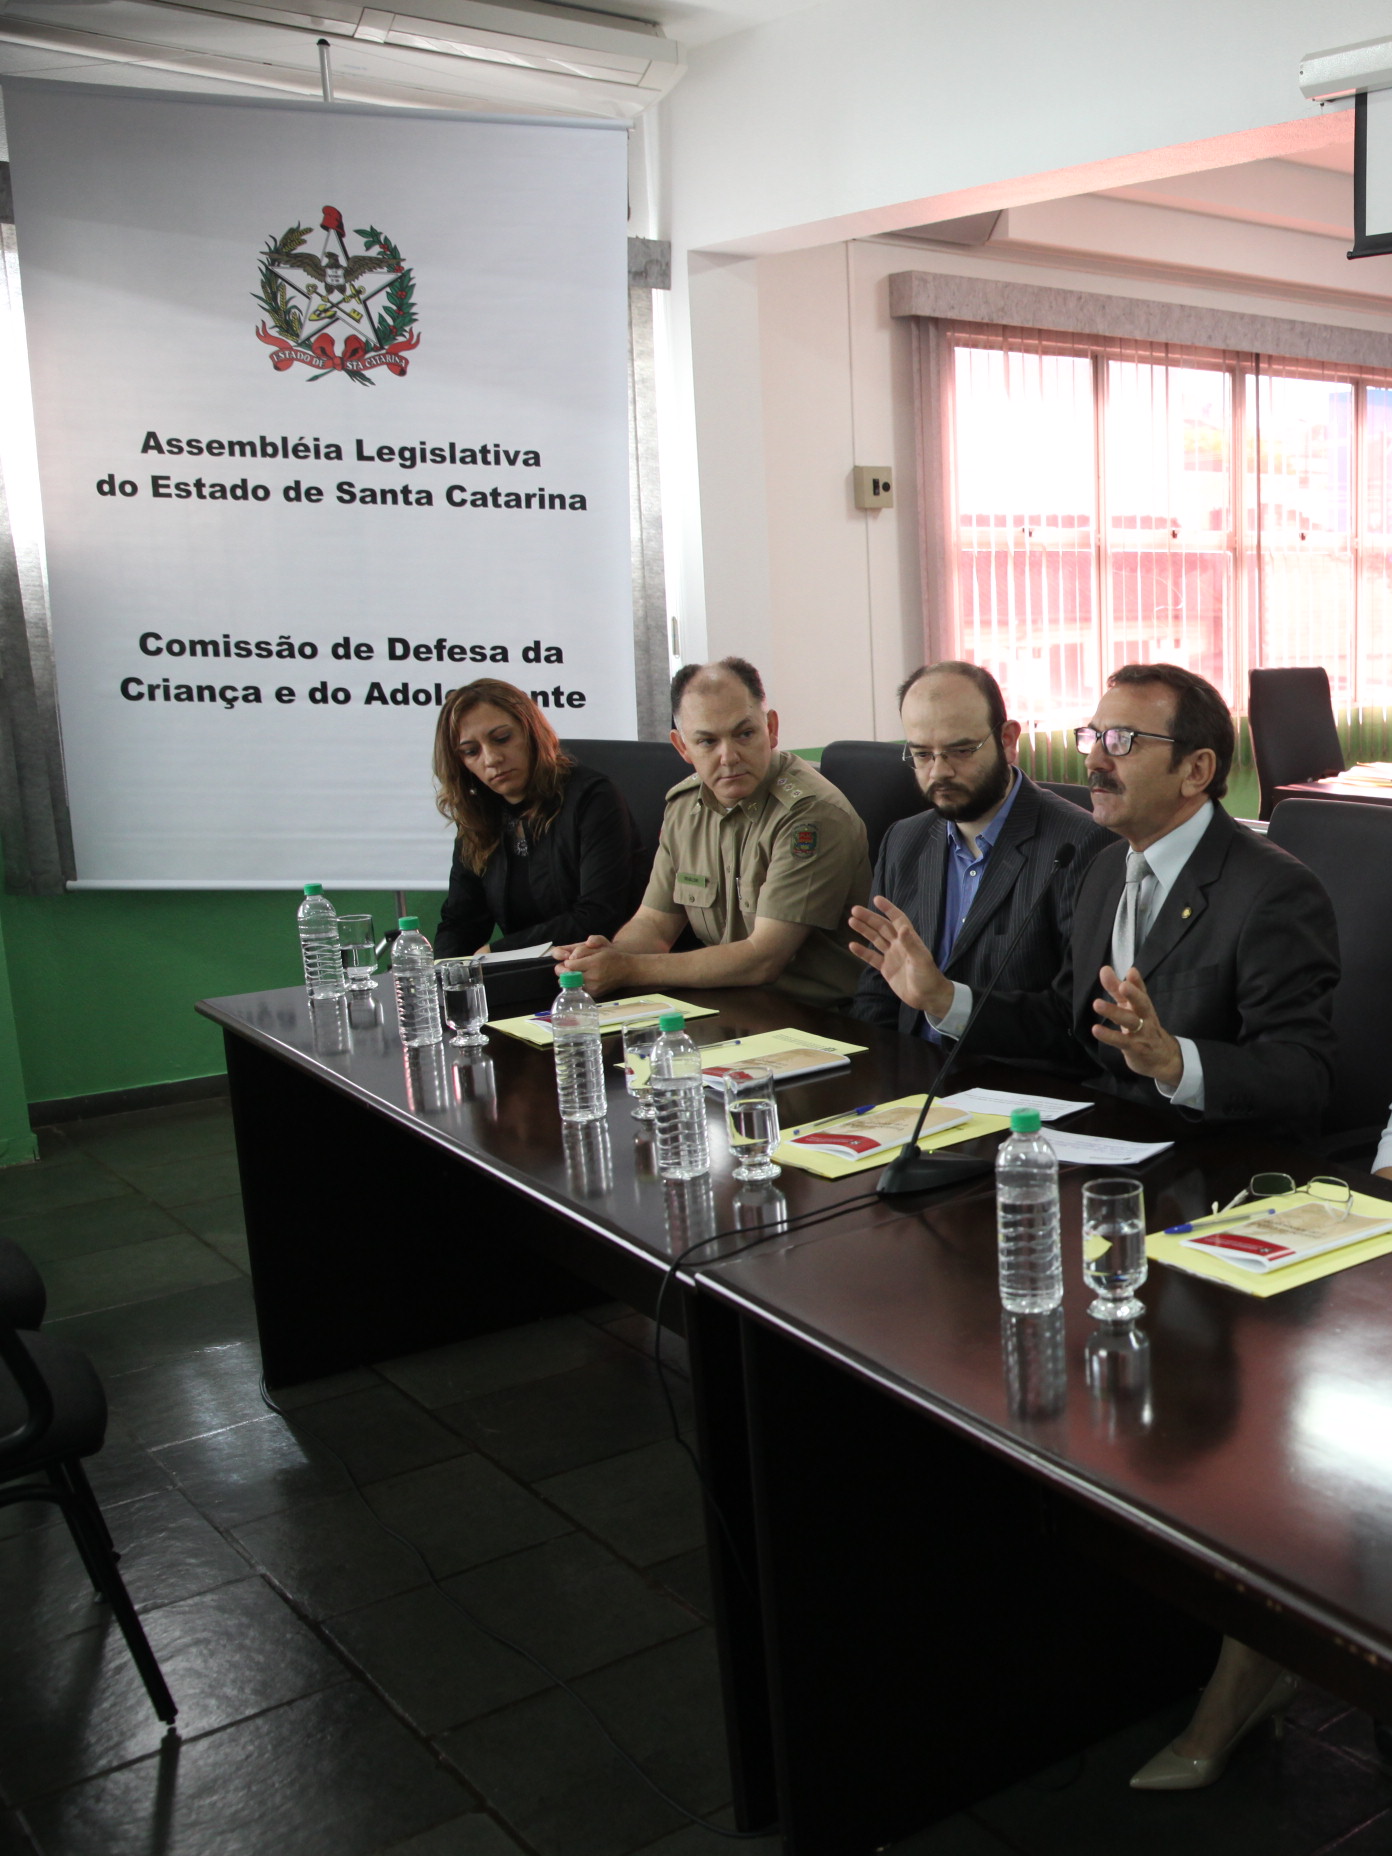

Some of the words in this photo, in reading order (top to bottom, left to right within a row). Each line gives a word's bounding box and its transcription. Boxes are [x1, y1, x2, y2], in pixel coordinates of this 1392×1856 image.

[272, 349, 310, 362] ESTADO
[312, 357, 325, 368] DE
[345, 360, 364, 370] STA
[365, 352, 406, 368] CATARINA
[141, 431, 343, 461] Assembléia
[355, 438, 541, 469] Legislativa
[96, 473, 138, 497] do
[151, 475, 271, 502] Estado
[283, 480, 324, 503] de
[336, 481, 433, 506] Santa
[445, 485, 587, 511] Catarina
[139, 631, 318, 660] Comissão
[331, 636, 374, 661] de
[387, 637, 509, 663] Defesa
[521, 640, 564, 664] da
[120, 676, 262, 710] Criança
[274, 686, 296, 704] e
[308, 680, 352, 705] do
[364, 681, 586, 709] Adolnte
